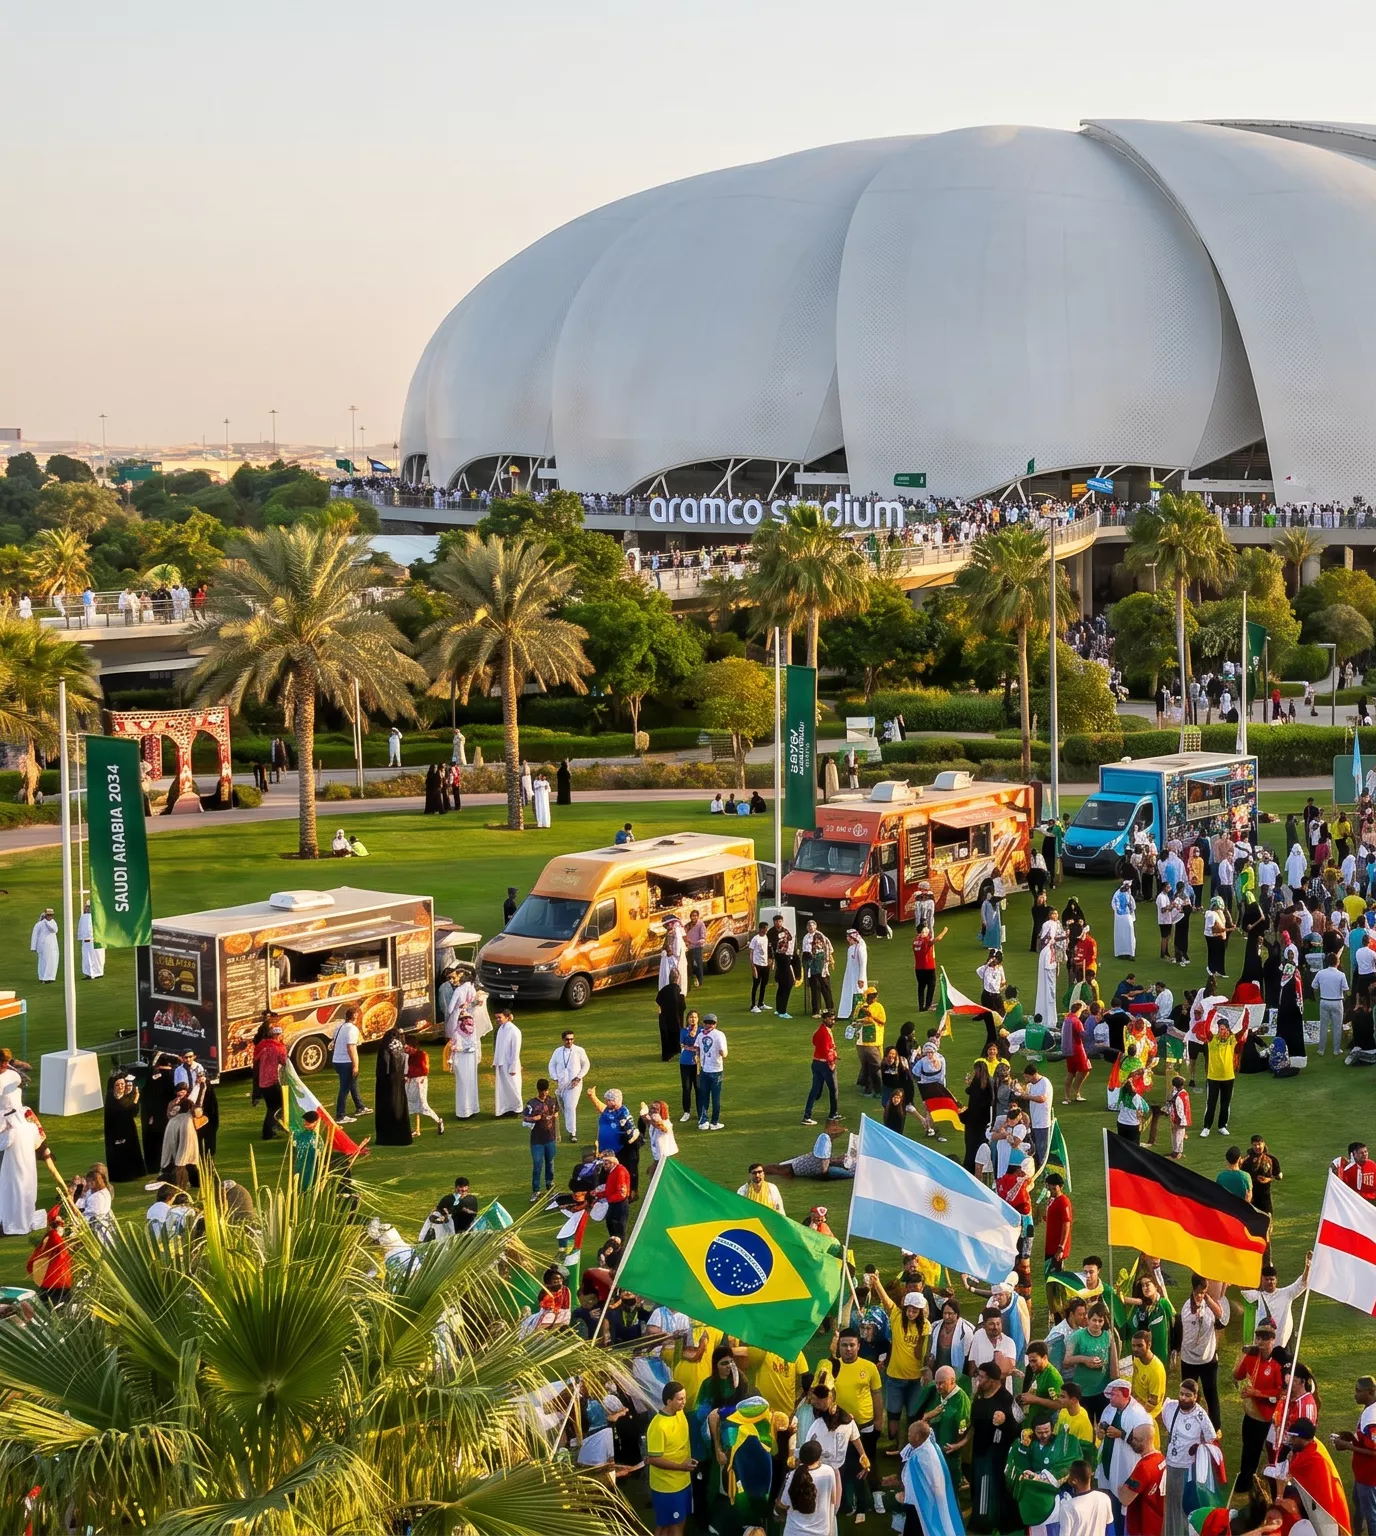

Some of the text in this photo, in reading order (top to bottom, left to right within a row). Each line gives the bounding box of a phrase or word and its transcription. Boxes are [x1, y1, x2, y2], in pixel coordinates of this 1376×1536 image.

[650, 497, 763, 525] aramco
[106, 764, 130, 913] SAUDI ARABIA 2034
